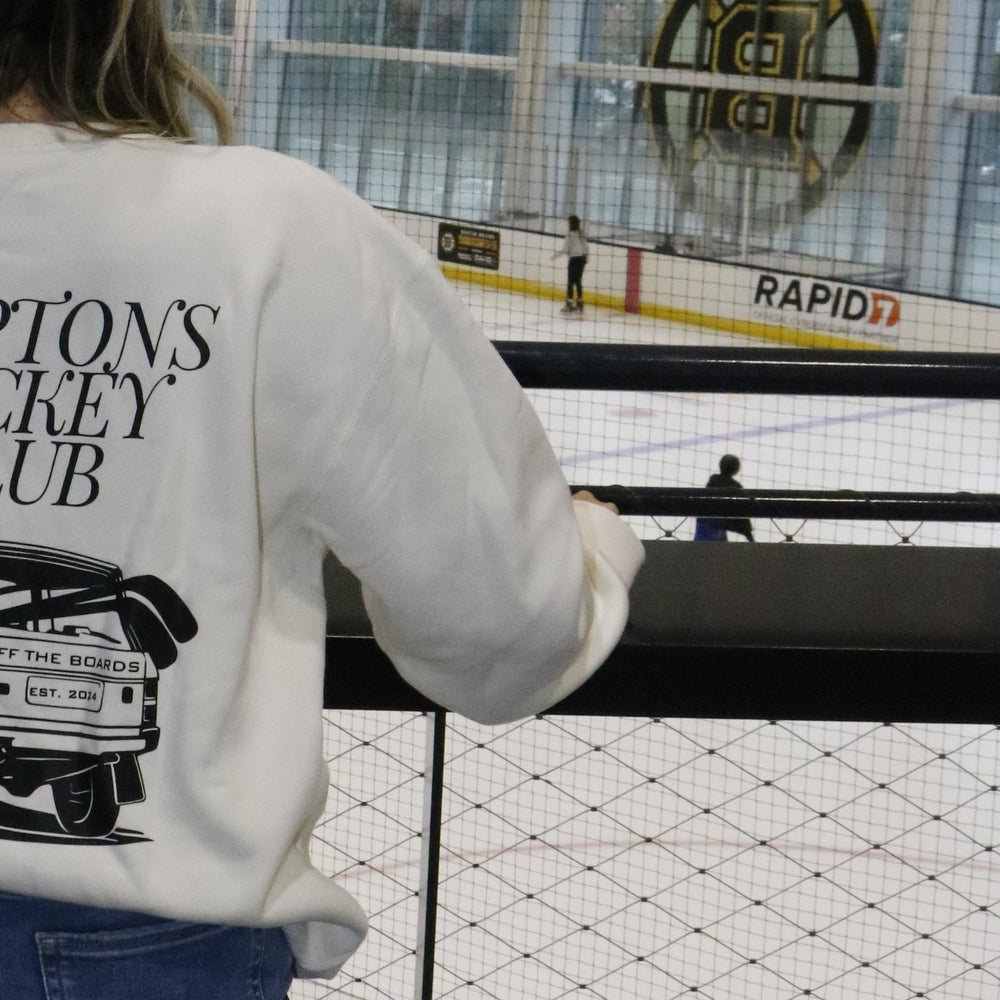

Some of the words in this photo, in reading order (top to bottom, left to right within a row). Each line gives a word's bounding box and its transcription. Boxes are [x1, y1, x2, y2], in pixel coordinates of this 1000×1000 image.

[24, 650, 62, 664] THE
[69, 655, 140, 673] BOARDS
[29, 687, 62, 699] EST.
[68, 690, 97, 701] 2024
